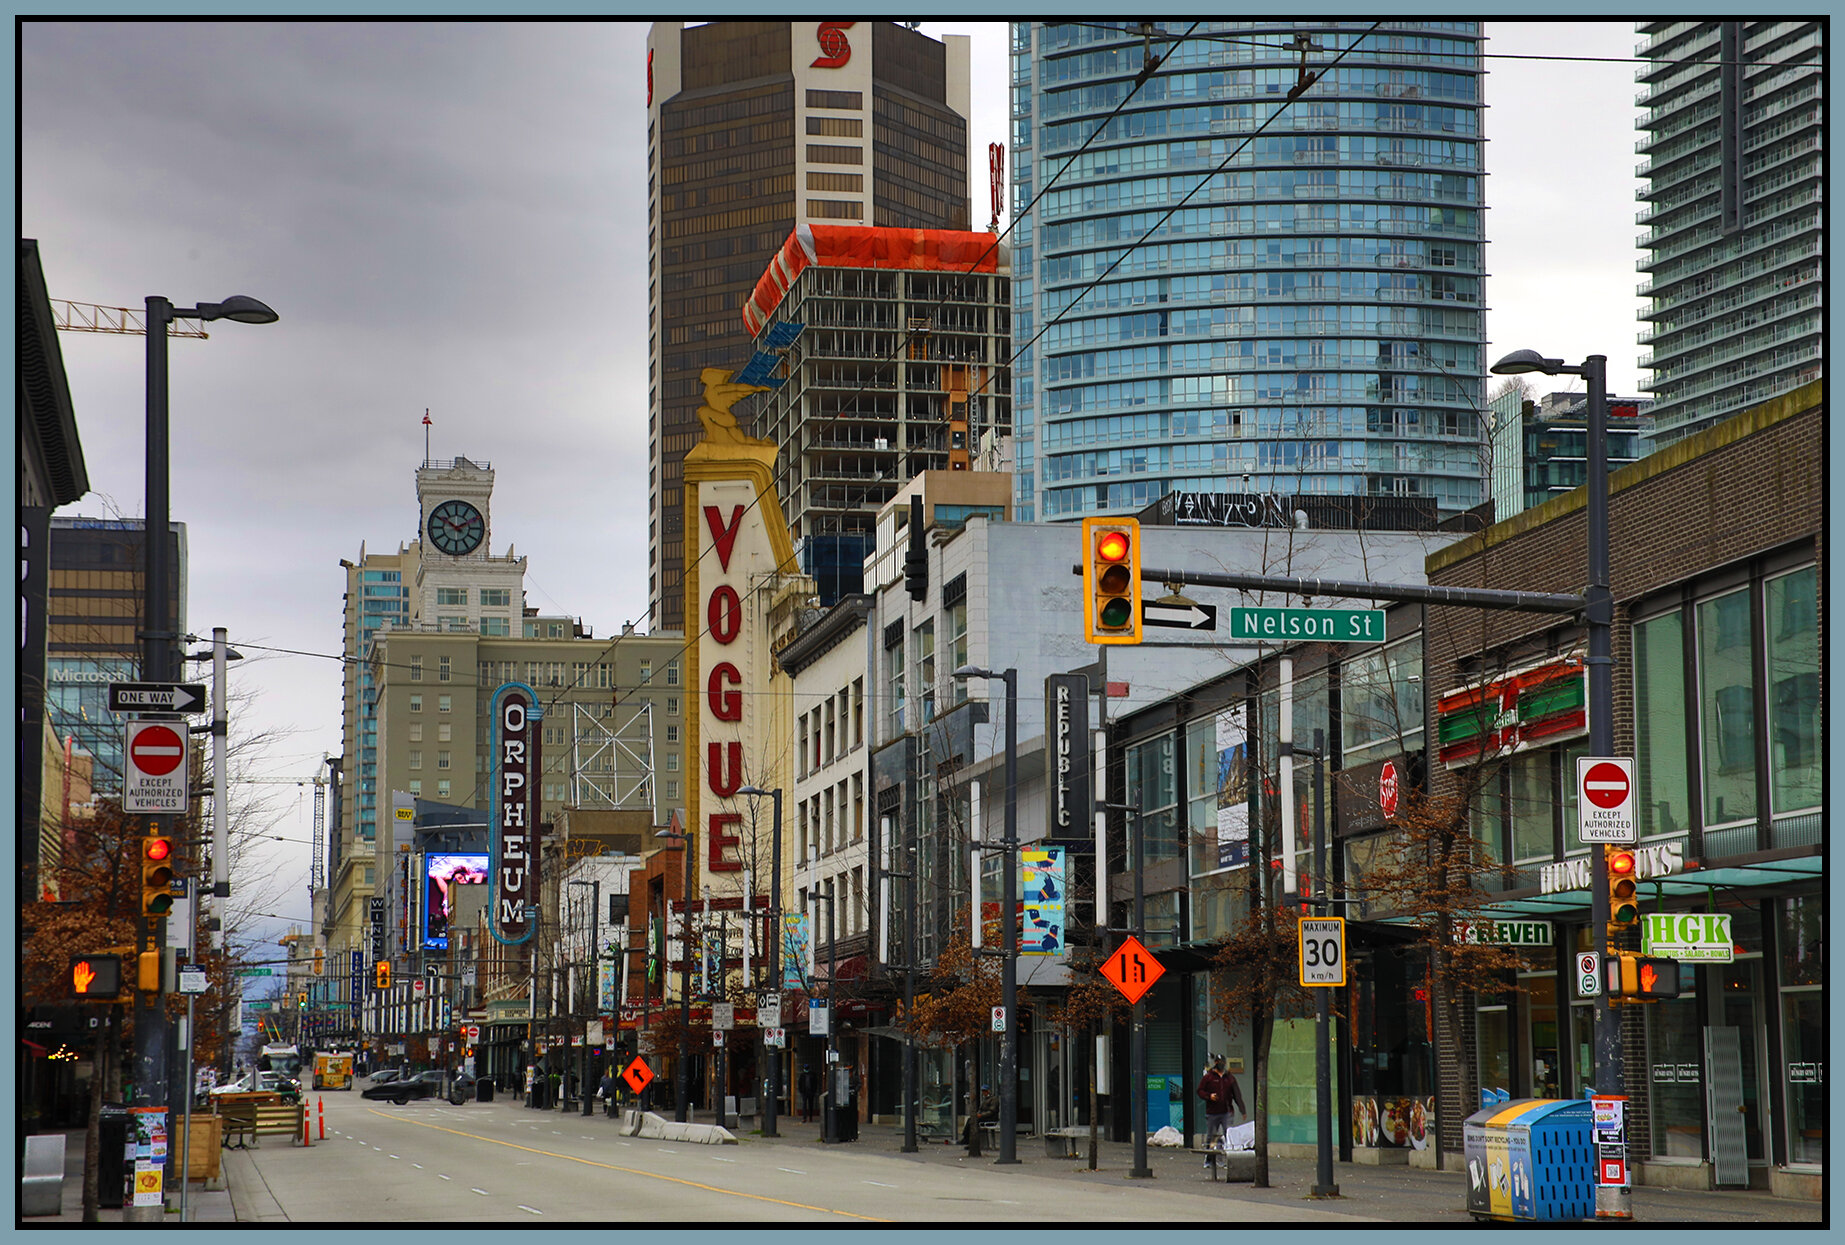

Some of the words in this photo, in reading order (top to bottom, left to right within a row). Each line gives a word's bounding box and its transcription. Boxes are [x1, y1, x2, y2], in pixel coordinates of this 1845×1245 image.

[1244, 612, 1334, 635] Nelson
[1349, 615, 1372, 636] St
[53, 668, 128, 682] Microsoft
[703, 505, 745, 872] VOGUE
[120, 692, 144, 703] ONE
[150, 692, 174, 703] WAY
[1057, 685, 1070, 827] REPUBLIC
[140, 778, 172, 787] EXCEPT
[129, 788, 183, 797] AUTHORIZED
[135, 798, 177, 807] VEHICLES
[501, 704, 525, 923] ORPHEUM
[1593, 811, 1621, 819] EXCEPT
[1584, 820, 1631, 829] AUTHORIZED
[1590, 829, 1626, 837] VEHICLES
[1303, 923, 1340, 932] MAXIMUM
[1650, 915, 1730, 944] HGK
[1306, 939, 1339, 966] 30
[1311, 972, 1334, 980] km/h
